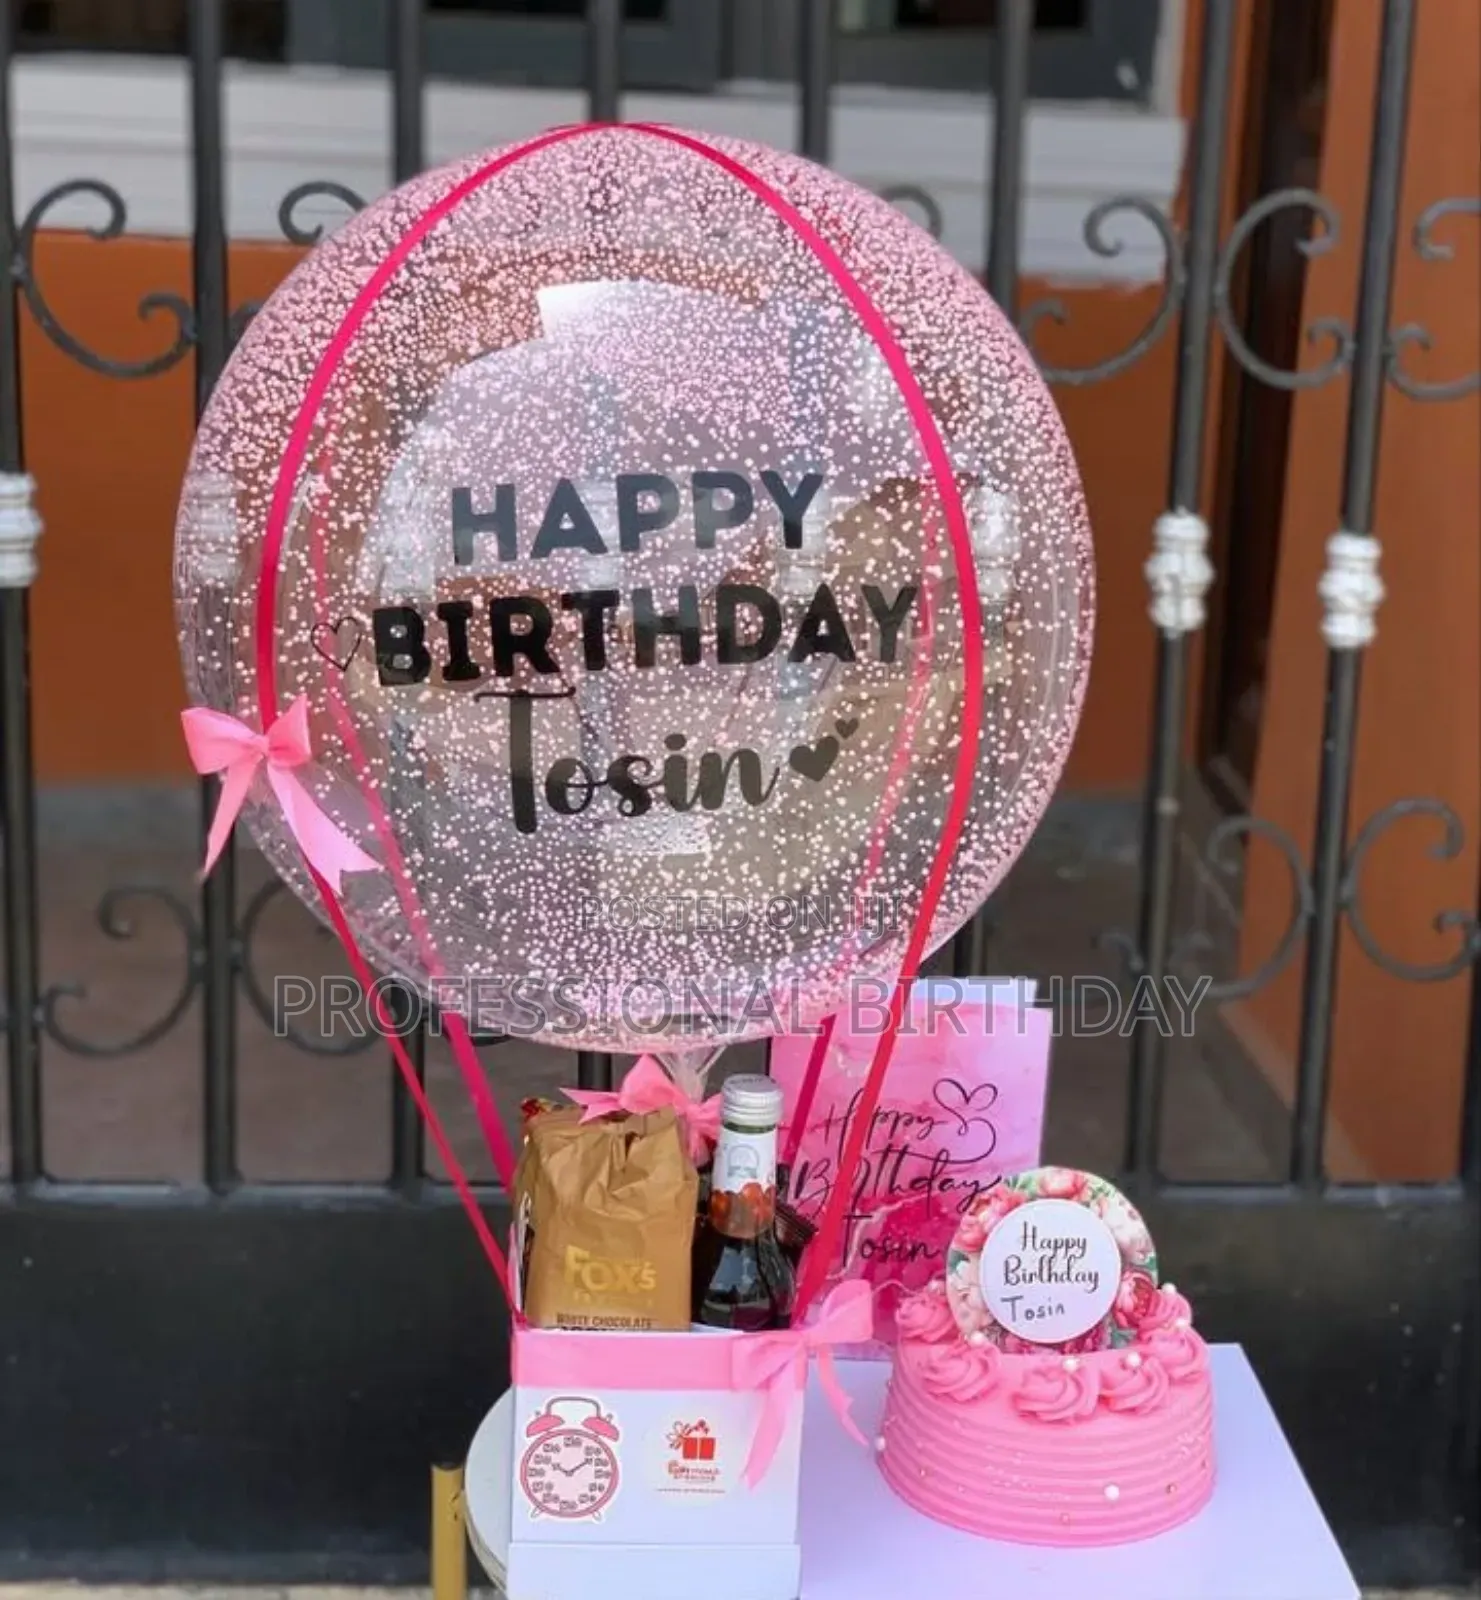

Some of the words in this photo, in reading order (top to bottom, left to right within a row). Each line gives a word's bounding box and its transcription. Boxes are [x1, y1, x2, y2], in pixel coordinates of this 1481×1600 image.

[450, 470, 825, 566] HAPPY
[372, 582, 918, 687] BIRTHDAY
[474, 688, 780, 834] Tosin
[800, 1087, 947, 1160] Hppy
[843, 1215, 938, 1267] Tosin
[1021, 1221, 1087, 1259] Happy
[1003, 1254, 1099, 1294] Birthday
[1000, 1295, 1065, 1322] Tosin
